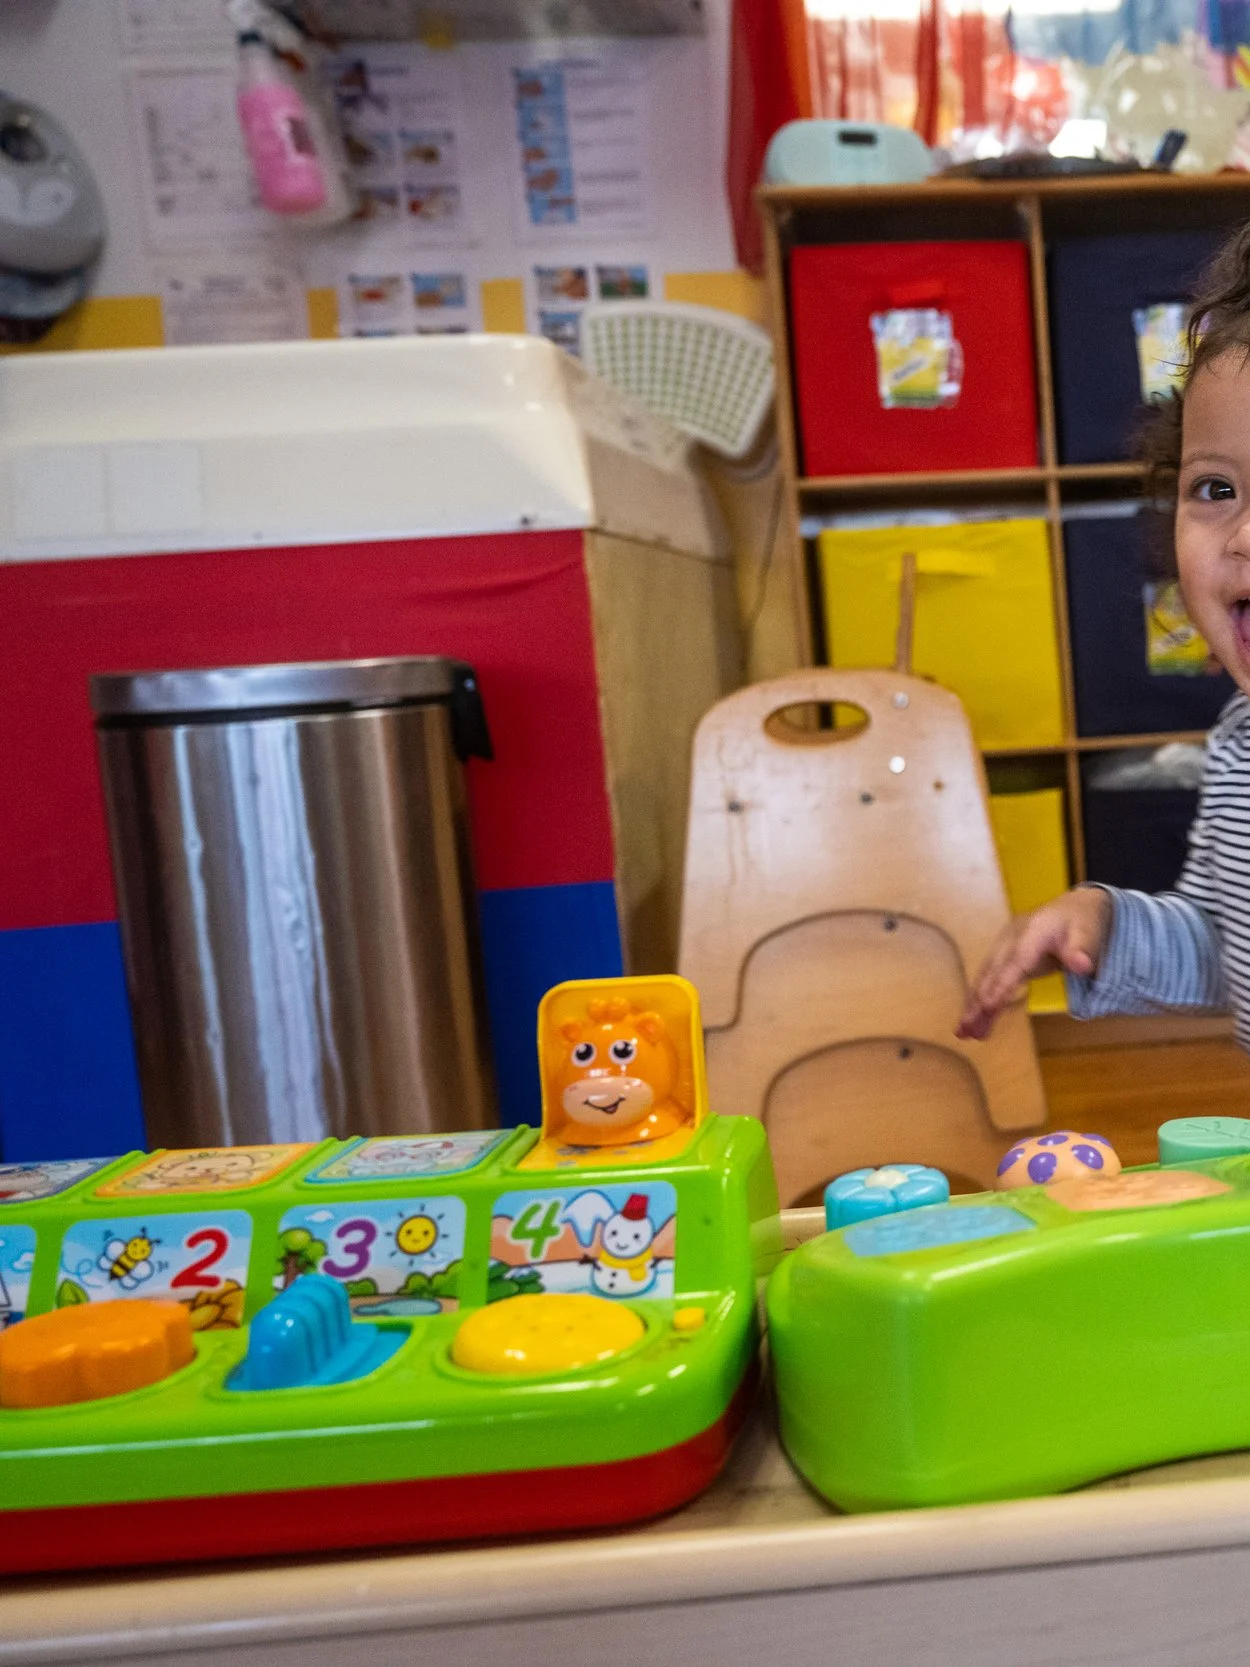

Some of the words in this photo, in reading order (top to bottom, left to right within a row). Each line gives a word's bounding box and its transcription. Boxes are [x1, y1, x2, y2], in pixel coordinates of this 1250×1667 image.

[170, 1228, 229, 1288] 2
[323, 1219, 377, 1278] 3
[511, 1199, 562, 1258] 4
